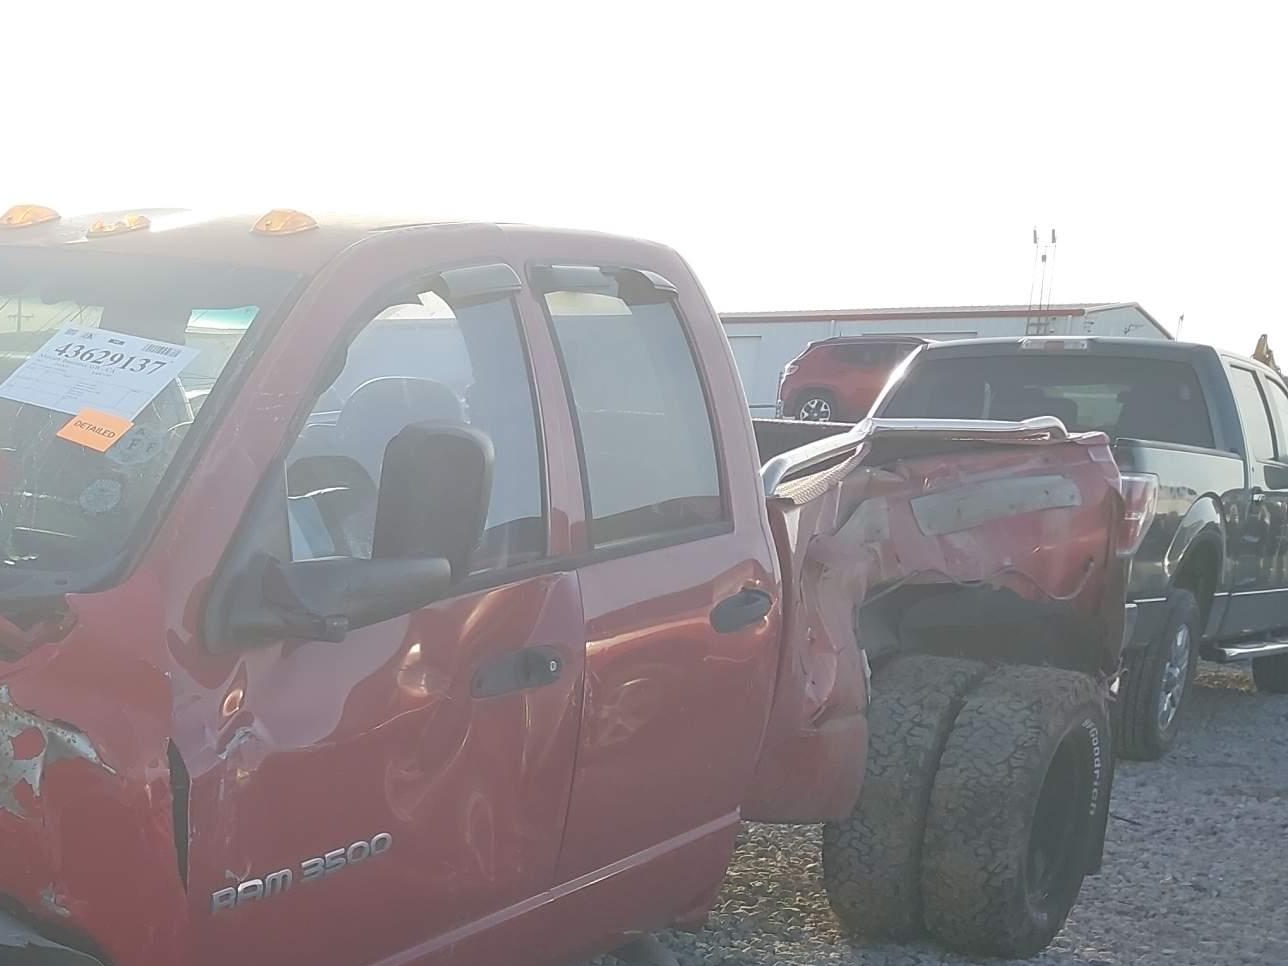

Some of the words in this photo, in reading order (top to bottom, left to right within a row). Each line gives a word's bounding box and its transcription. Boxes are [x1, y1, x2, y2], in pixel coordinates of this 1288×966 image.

[54, 342, 167, 376] 43629137
[74, 418, 116, 439] DETAILED
[210, 868, 293, 914] RAM
[300, 831, 393, 882] 3500
